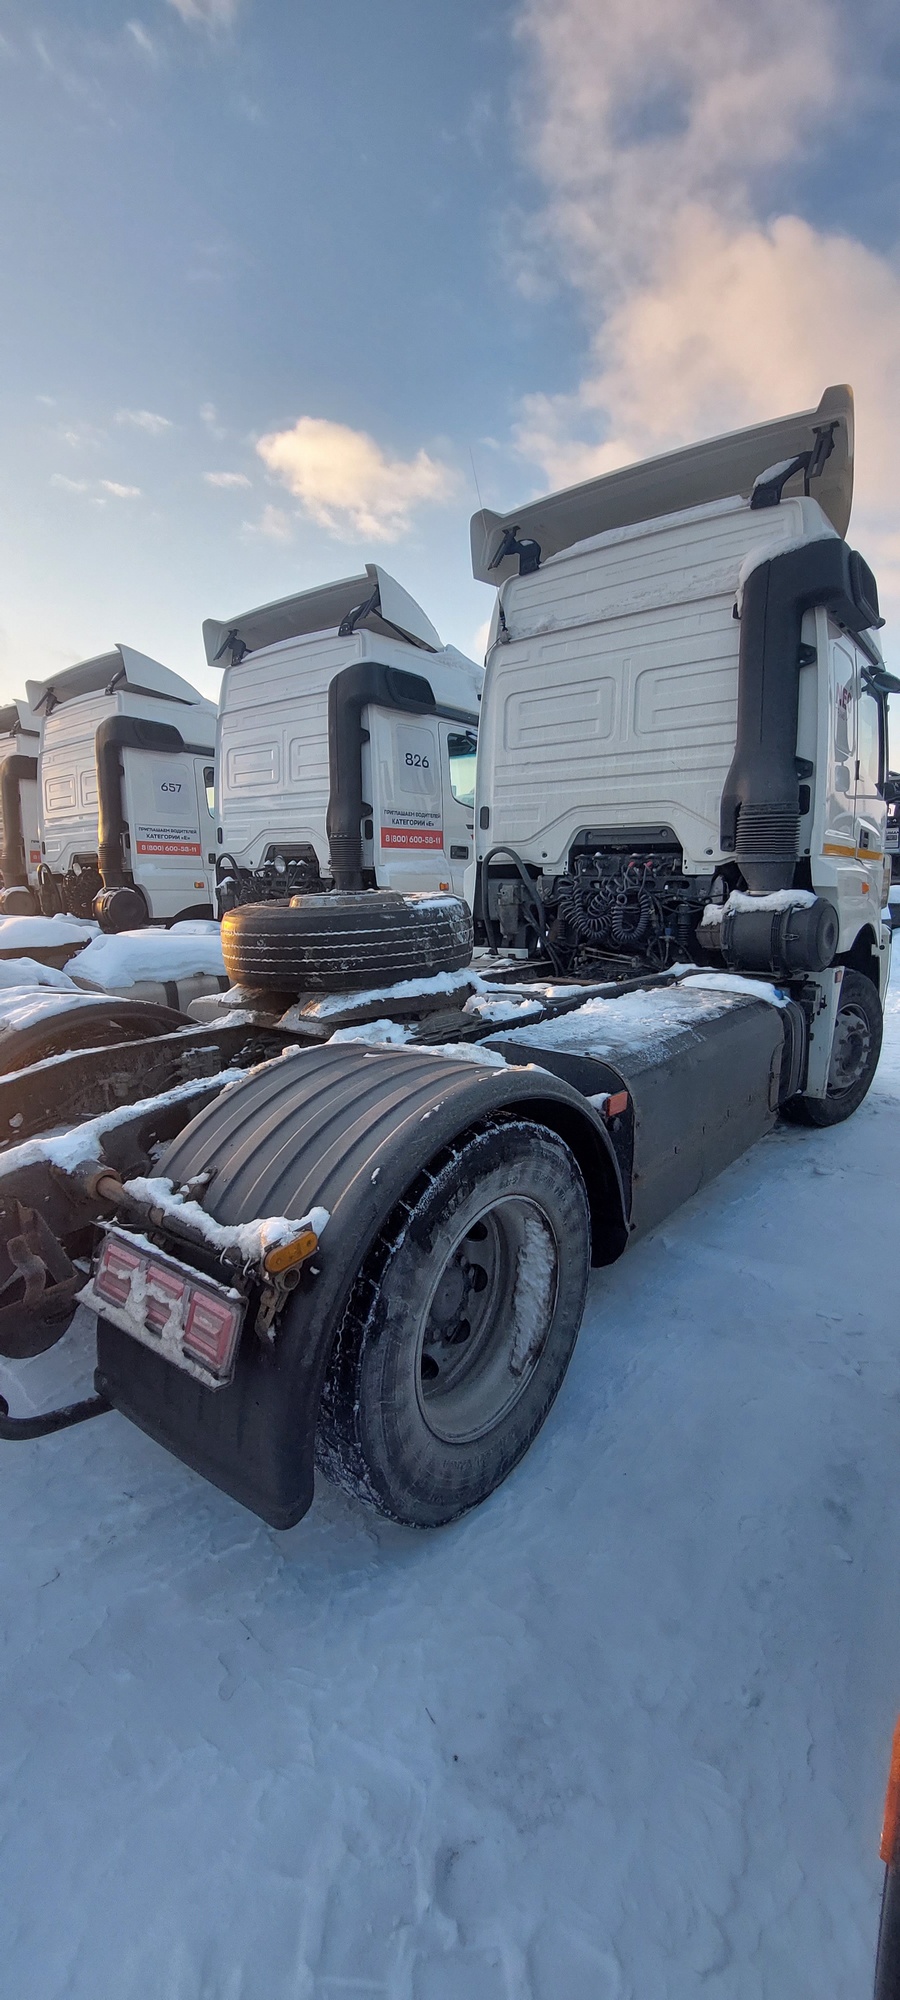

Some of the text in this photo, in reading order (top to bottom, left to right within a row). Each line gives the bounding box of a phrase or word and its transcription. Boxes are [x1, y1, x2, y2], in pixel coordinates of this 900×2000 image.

[405, 752, 429, 768] 826
[161, 782, 182, 793] 657
[384, 809, 415, 817] ПРИГЛАШАЕМ
[392, 818, 425, 826] КАТЕГОРИИ
[386, 834, 441, 844] 8 (800) 600-58-11
